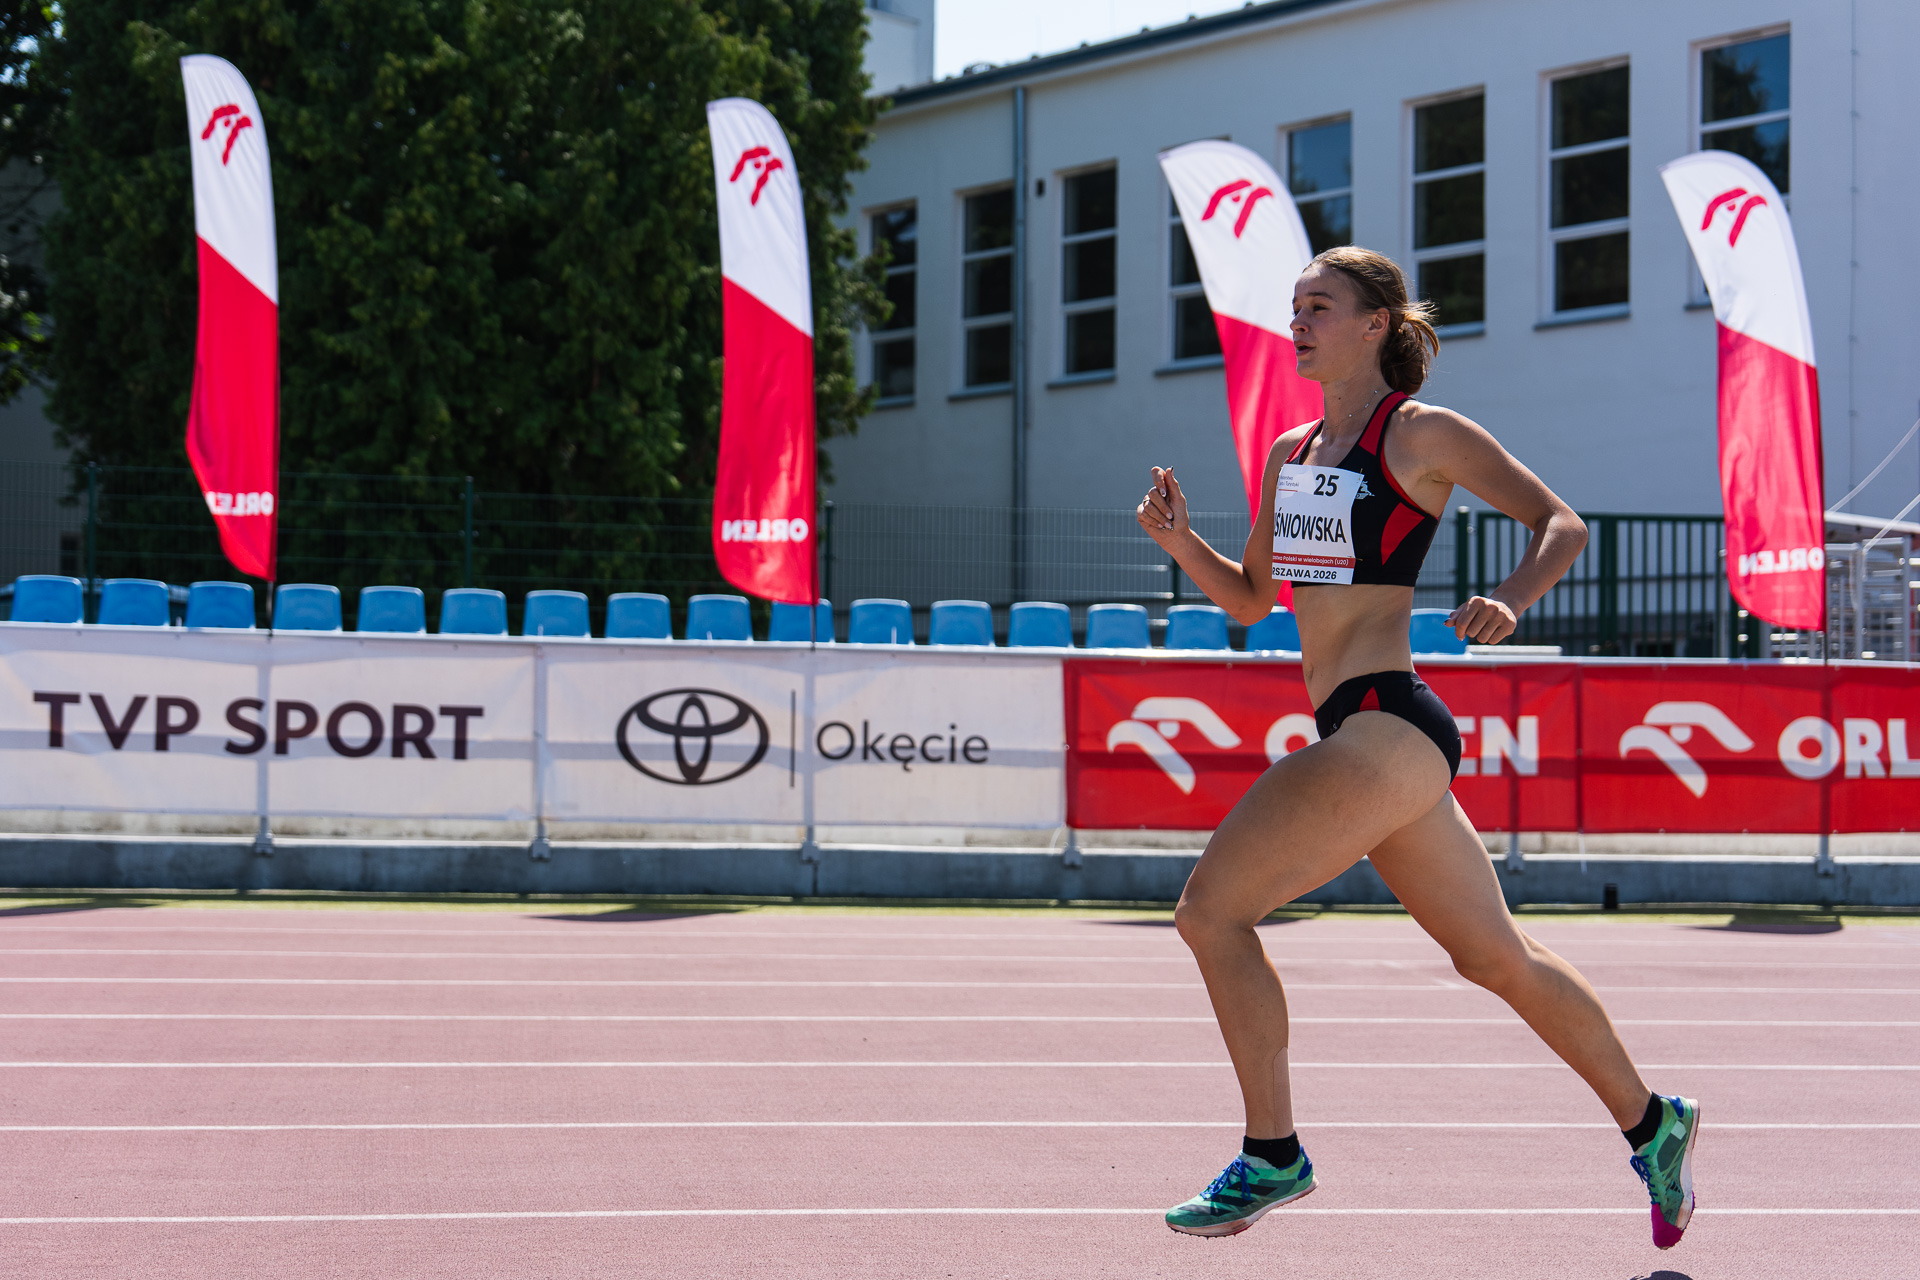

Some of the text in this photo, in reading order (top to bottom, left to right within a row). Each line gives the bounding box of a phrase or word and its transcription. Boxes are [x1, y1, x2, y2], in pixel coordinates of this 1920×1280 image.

[1313, 473, 1340, 497] 25
[1303, 557, 1333, 566] wielobojach
[1312, 569, 1337, 580] 2026
[33, 690, 484, 761] TVP SPORT
[816, 719, 989, 771] Okęcie
